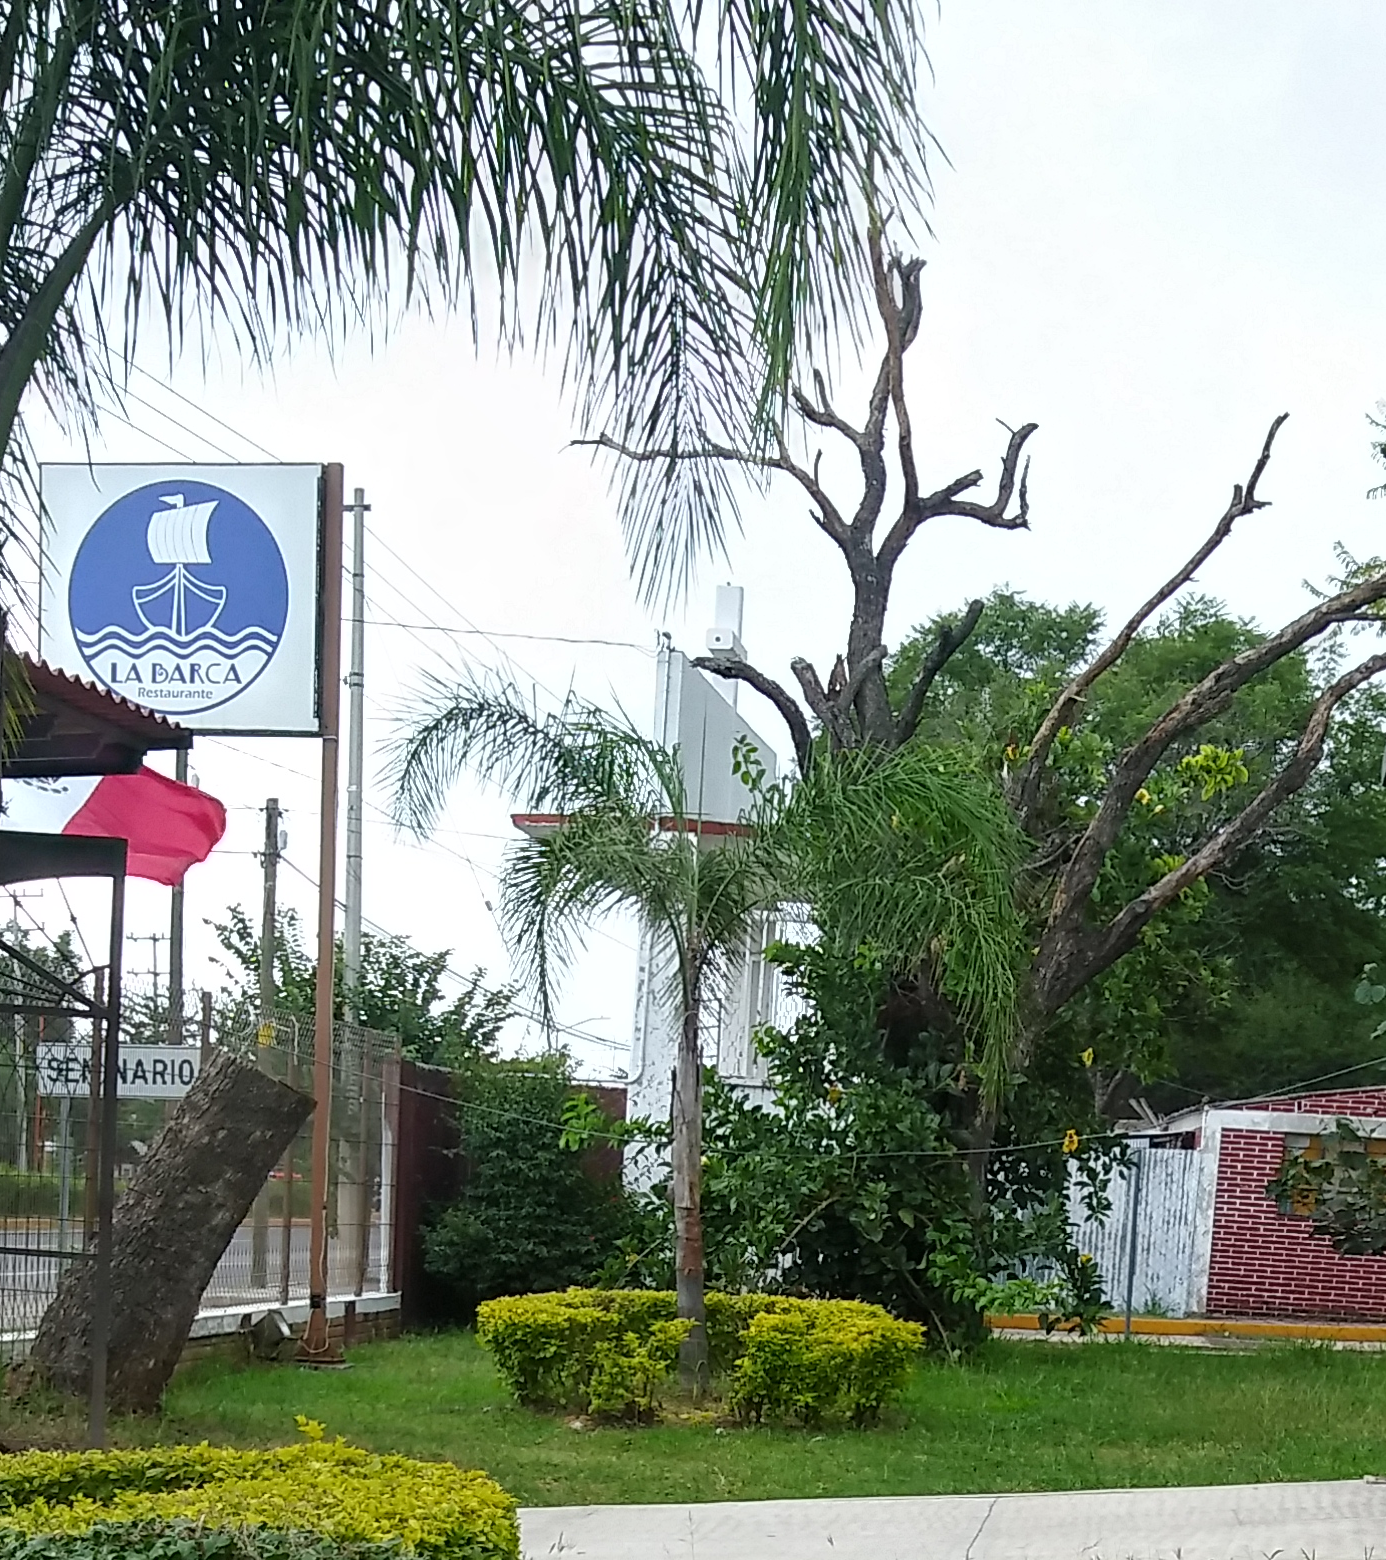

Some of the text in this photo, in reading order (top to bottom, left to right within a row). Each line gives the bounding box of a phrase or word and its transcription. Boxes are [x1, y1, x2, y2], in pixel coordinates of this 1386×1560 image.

[110, 662, 243, 685] LA BARCA
[137, 687, 214, 700] Restaurante
[47, 1056, 195, 1086] SENARIO
